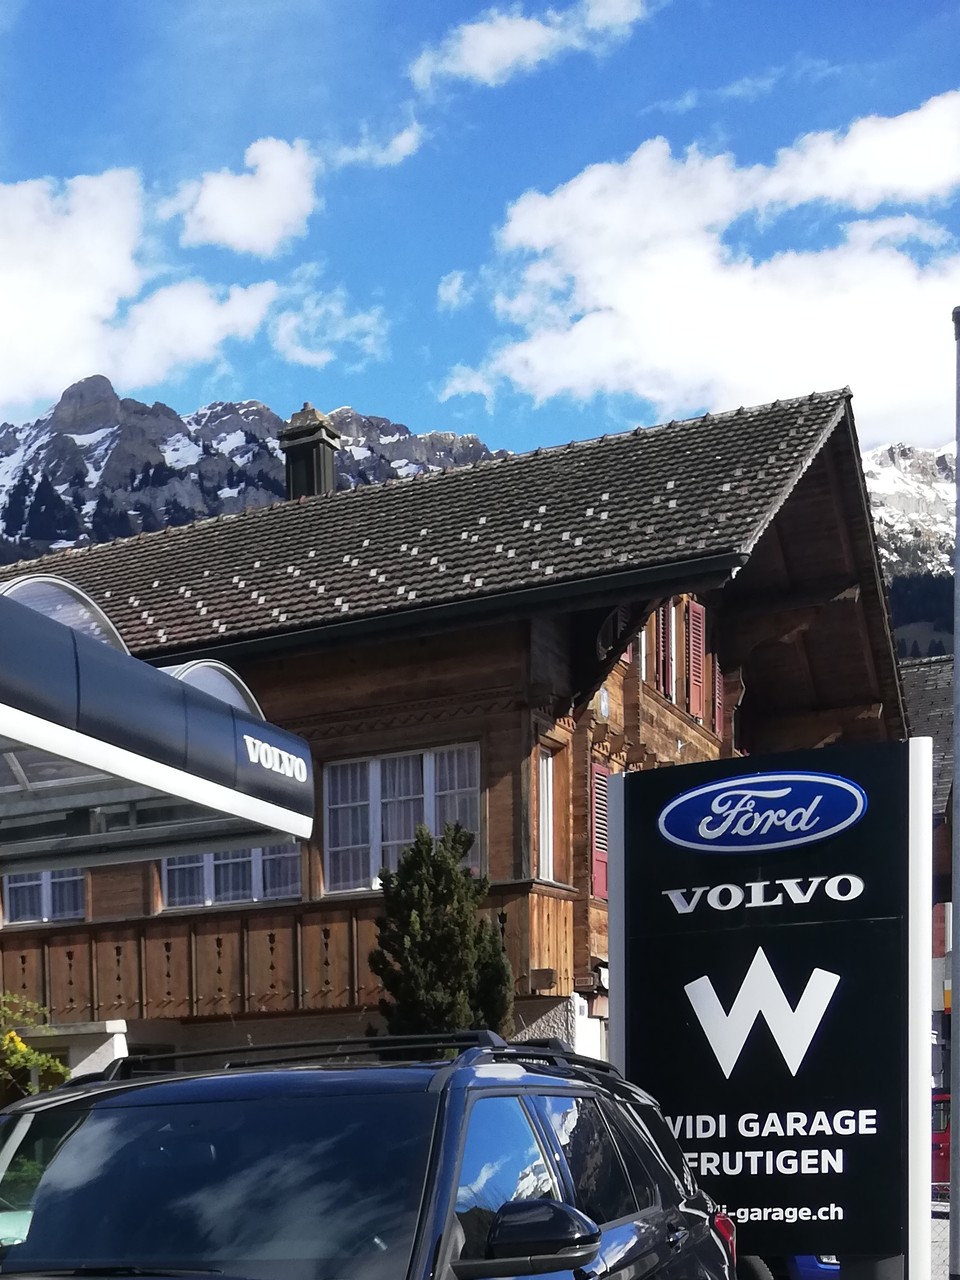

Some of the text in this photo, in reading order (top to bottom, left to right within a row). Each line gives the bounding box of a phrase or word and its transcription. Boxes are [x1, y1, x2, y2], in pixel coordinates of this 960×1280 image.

[243, 734, 308, 783] VOLVO
[698, 786, 824, 840] Ford
[662, 873, 865, 915] VOLVO
[684, 945, 841, 1080] W
[738, 1109, 877, 1138] GARAGE
[683, 1149, 844, 1176] FRUTIGEN
